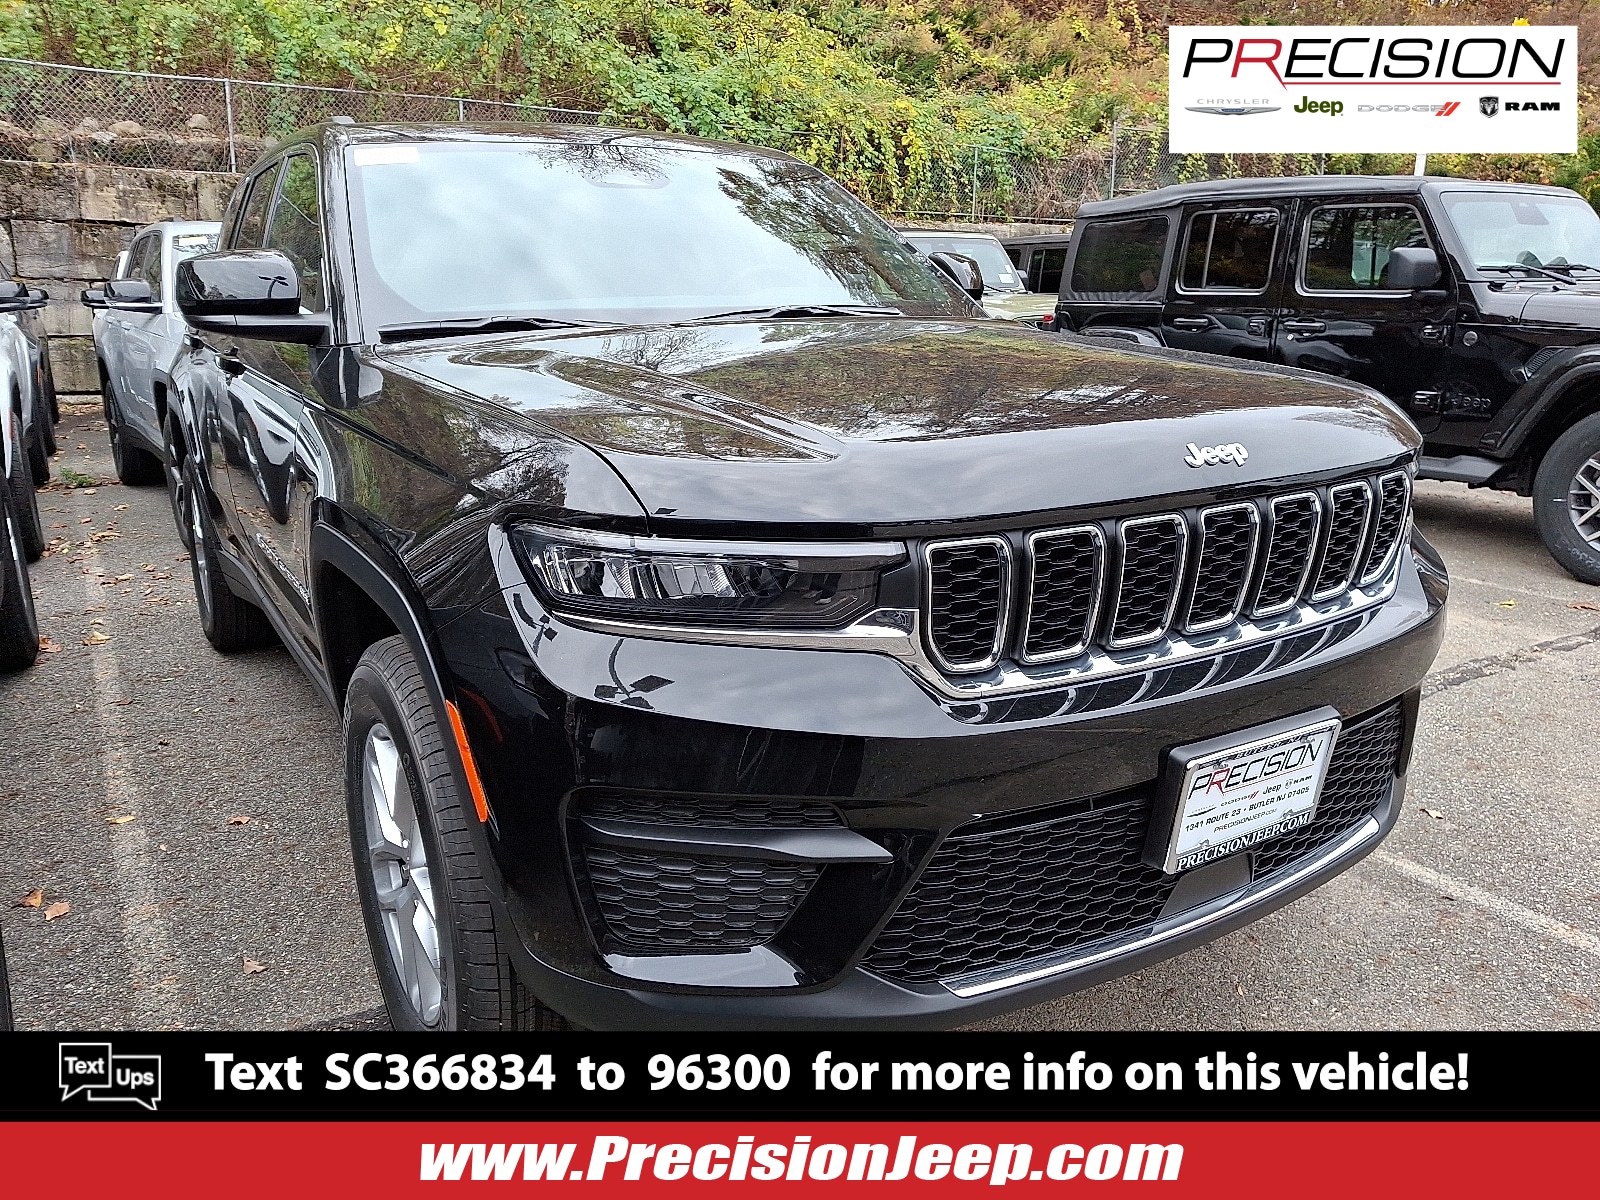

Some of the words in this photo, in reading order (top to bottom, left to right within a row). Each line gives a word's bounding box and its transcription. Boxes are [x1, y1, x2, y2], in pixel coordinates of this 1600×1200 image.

[1184, 442, 1249, 469] Jeep
[1188, 739, 1324, 800] PRECISION
[1262, 784, 1282, 795] Jeep
[1185, 819, 1204, 833] 1341
[1206, 811, 1230, 826] ROUTE
[1231, 808, 1242, 817] 23
[1249, 797, 1275, 811] BUTLER
[1276, 792, 1287, 802] NJ
[1287, 786, 1310, 799] 07405
[1177, 812, 1311, 872] PRECISIONJEEP.COM
